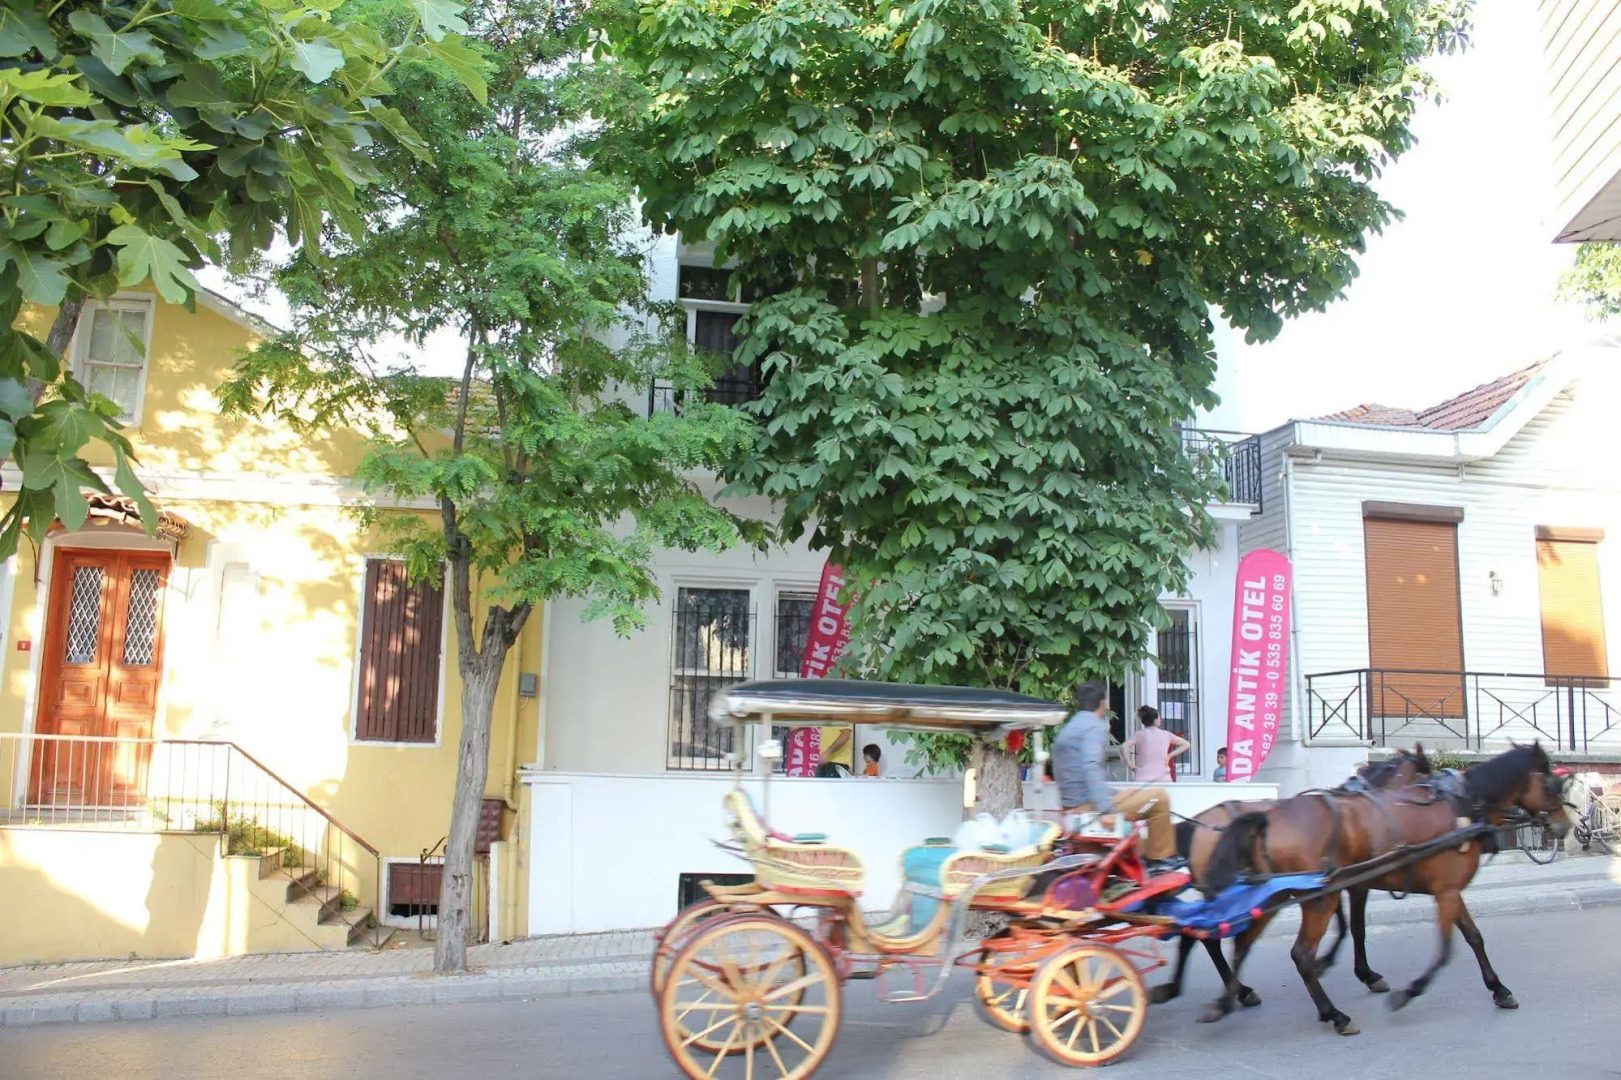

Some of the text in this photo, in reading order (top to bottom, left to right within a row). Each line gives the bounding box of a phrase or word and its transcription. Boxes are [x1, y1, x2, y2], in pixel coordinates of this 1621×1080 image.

[1273, 574, 1286, 591] 69
[1241, 576, 1266, 641] OTEL
[1272, 594, 1284, 612] 60
[1268, 614, 1283, 640] 835
[806, 641, 831, 679] TİK
[1267, 642, 1281, 668] 535
[1266, 671, 1280, 680] 0
[1232, 648, 1261, 731] ANTİK
[1264, 692, 1278, 709] 39
[1264, 712, 1277, 730] 38
[1261, 733, 1273, 757] 382
